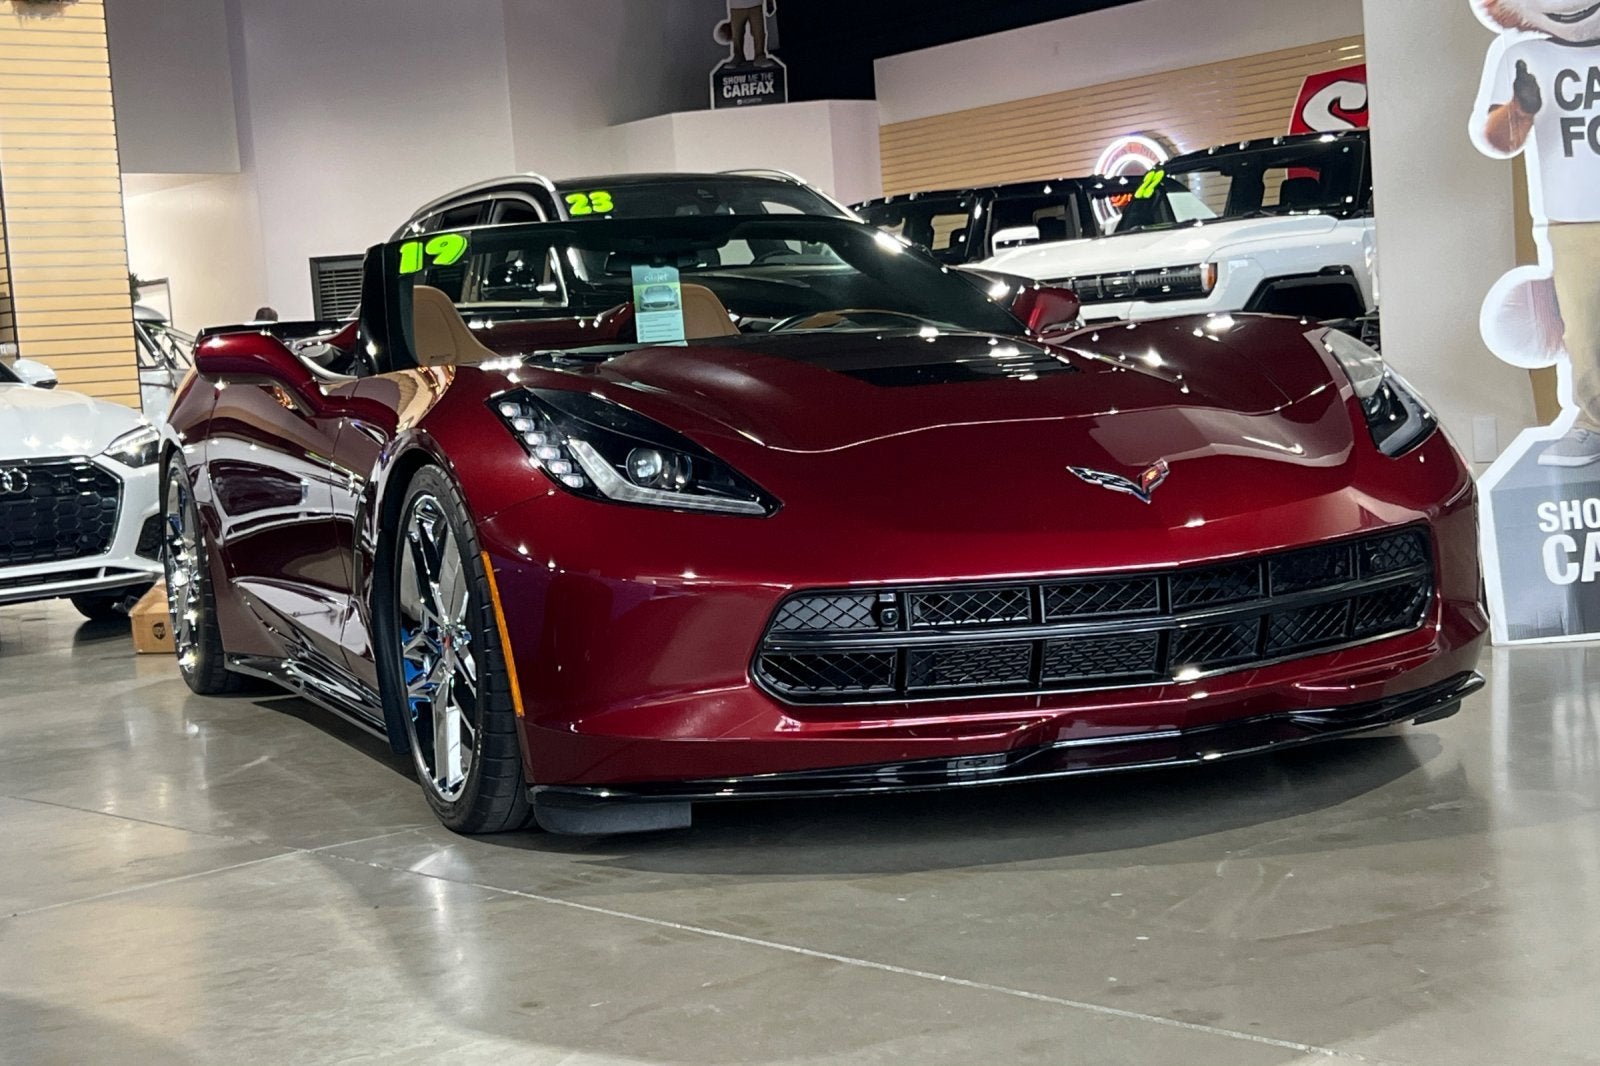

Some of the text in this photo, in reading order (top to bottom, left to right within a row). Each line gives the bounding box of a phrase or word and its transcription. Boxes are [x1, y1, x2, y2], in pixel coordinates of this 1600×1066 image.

[723, 75, 747, 86] SHOW
[723, 80, 774, 98] CARFAX
[1554, 66, 1600, 111] CA
[566, 191, 613, 215] 23
[399, 233, 467, 274] 19
[1537, 497, 1600, 532] SHO
